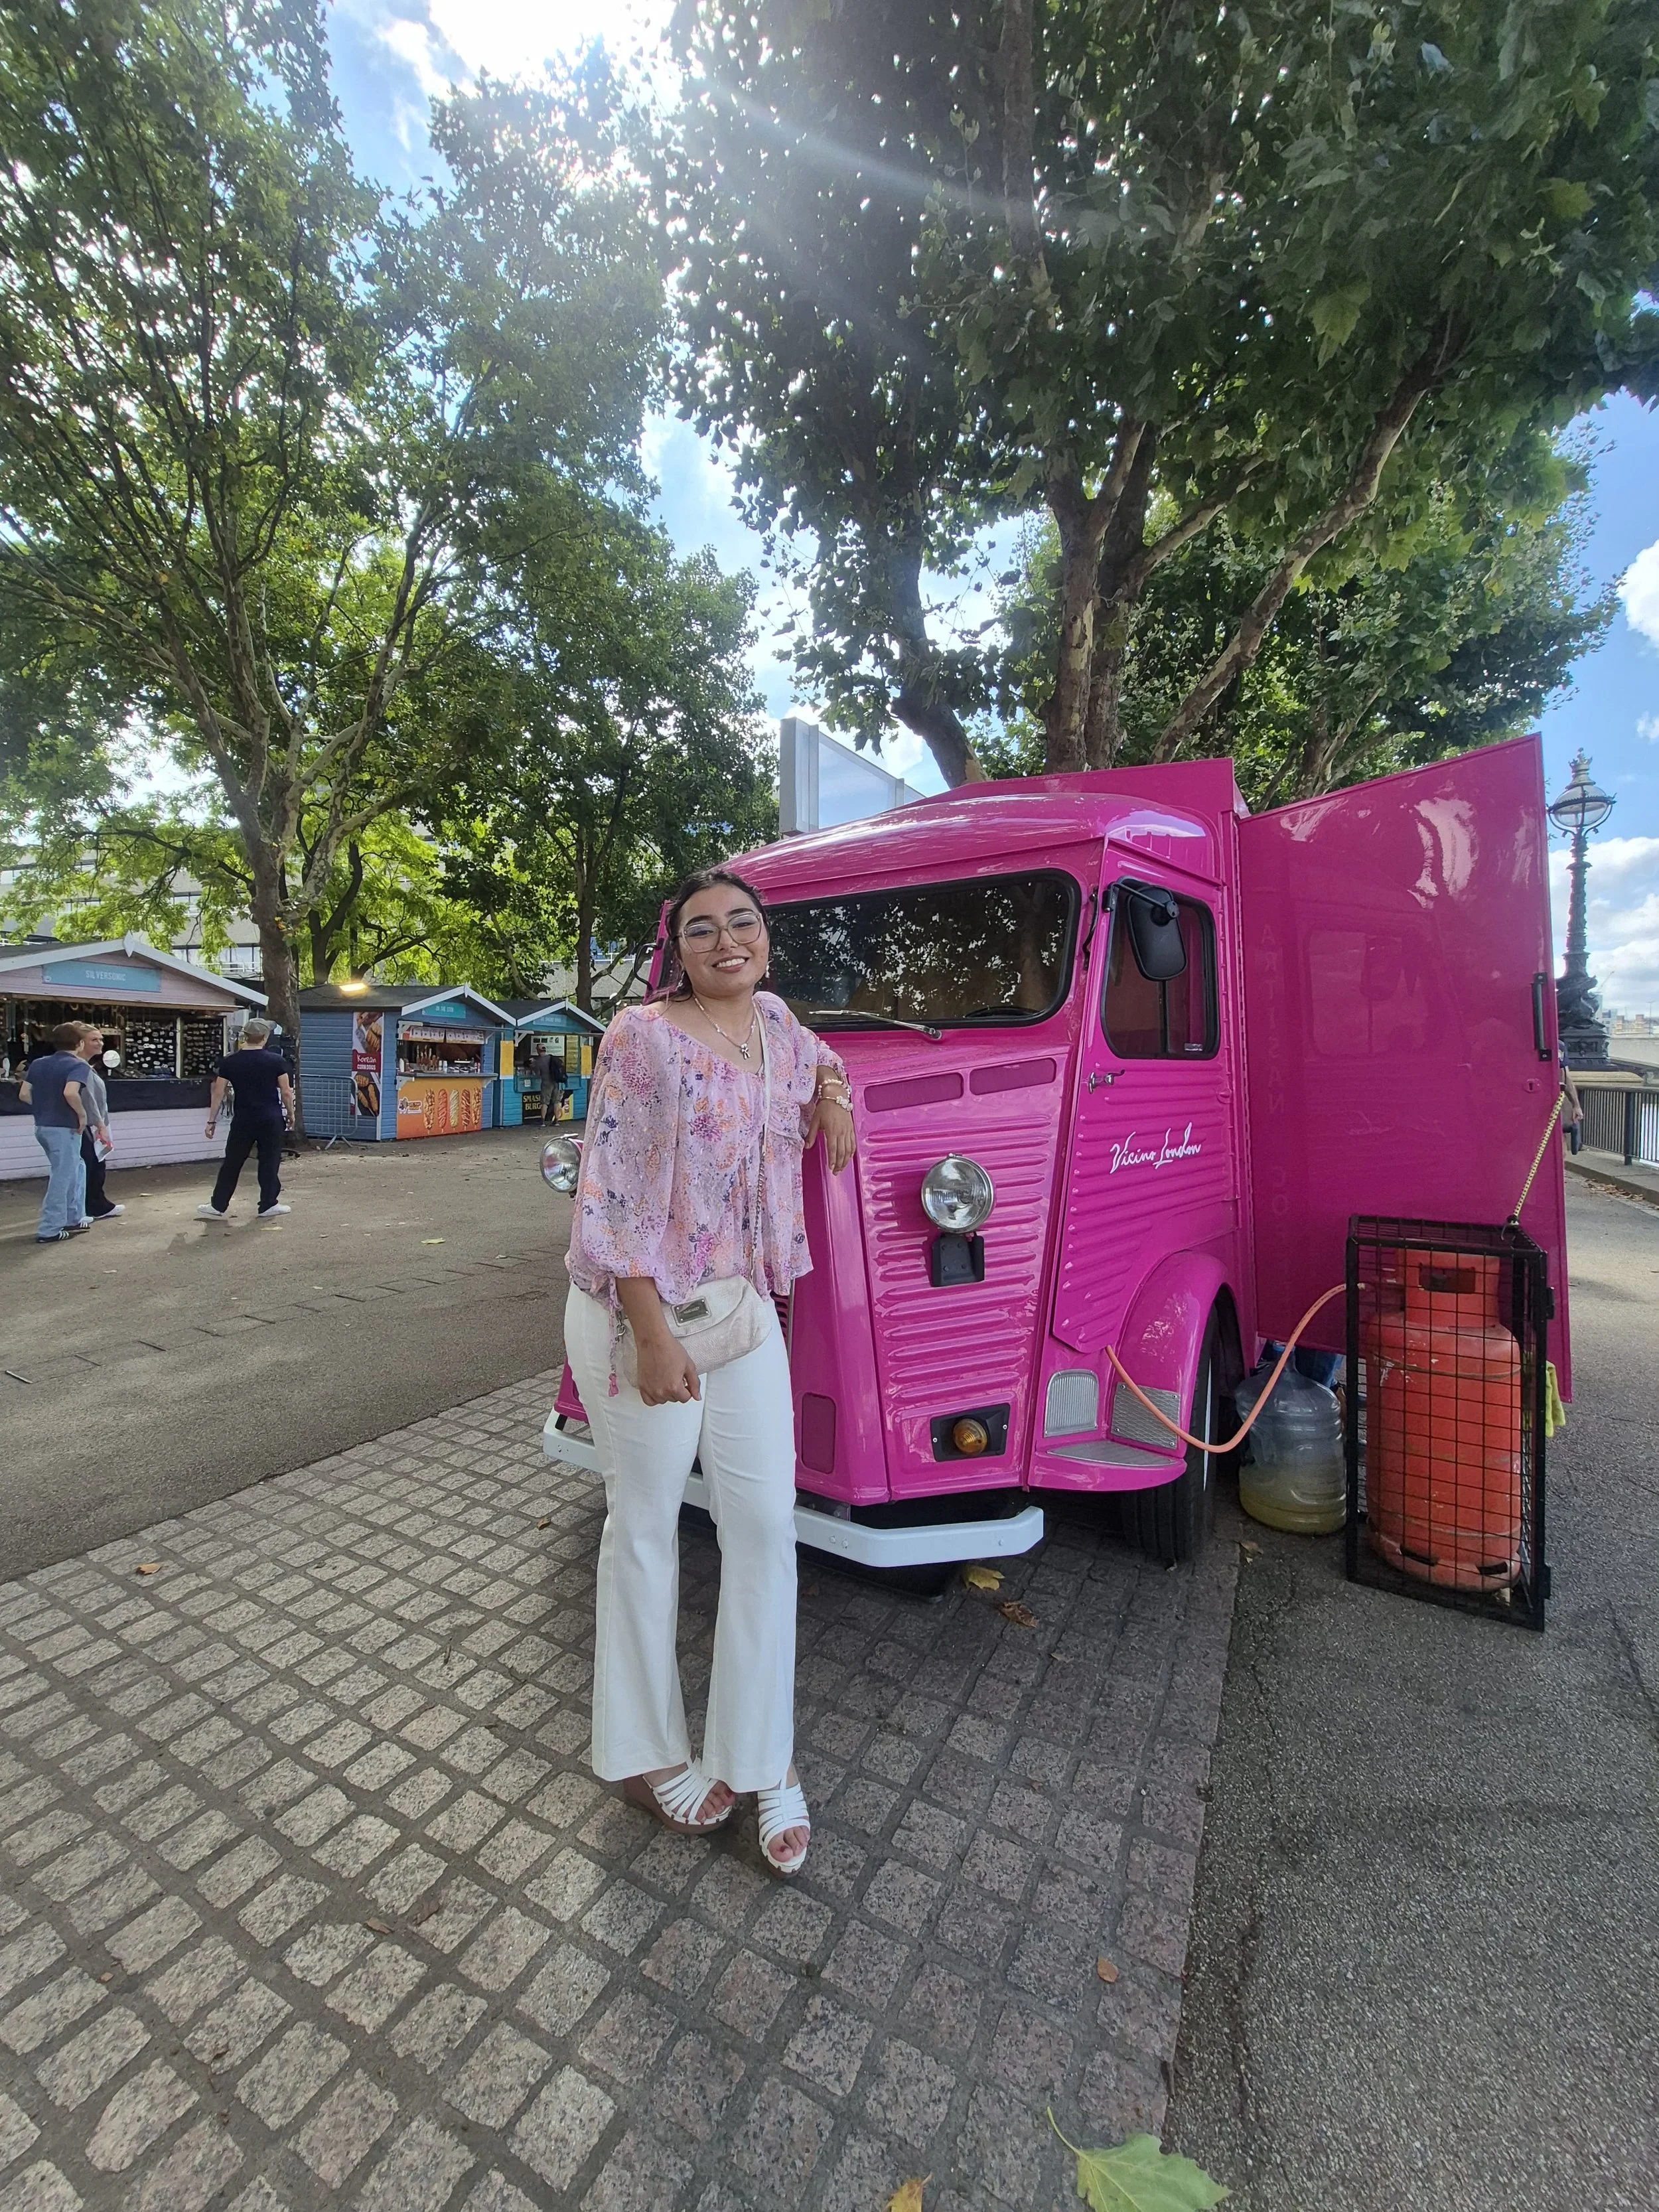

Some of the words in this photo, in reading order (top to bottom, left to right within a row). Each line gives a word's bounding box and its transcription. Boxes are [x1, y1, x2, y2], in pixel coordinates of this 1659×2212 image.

[86, 970, 126, 981] SILVERSONIC
[1110, 1131, 1156, 1174] Vicino
[1152, 1122, 1202, 1169] London
